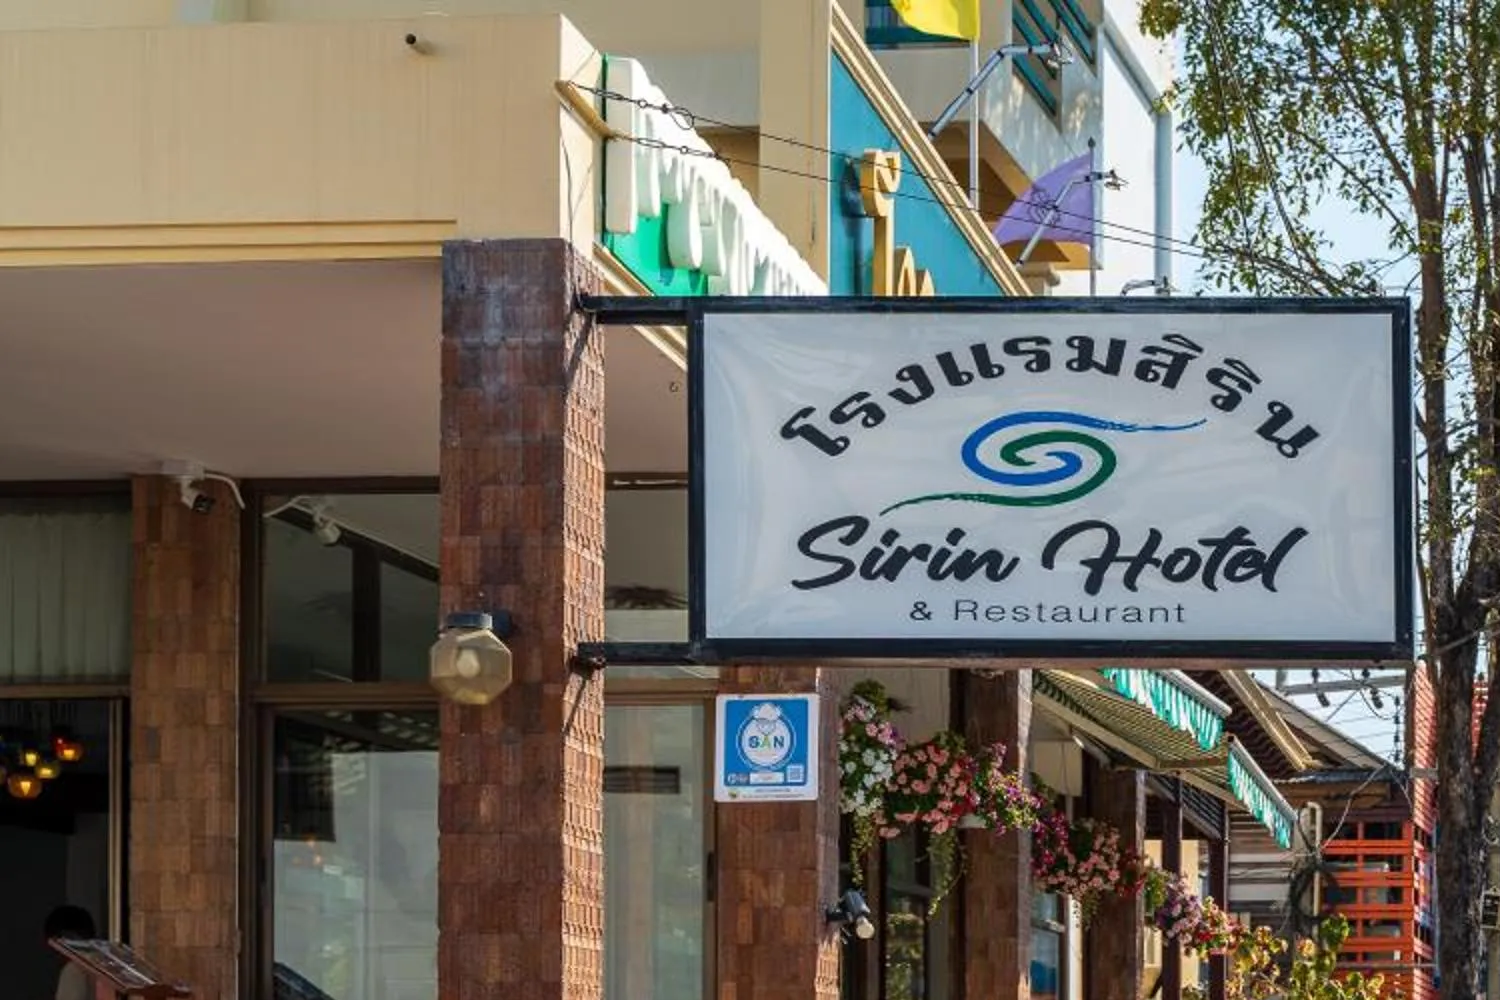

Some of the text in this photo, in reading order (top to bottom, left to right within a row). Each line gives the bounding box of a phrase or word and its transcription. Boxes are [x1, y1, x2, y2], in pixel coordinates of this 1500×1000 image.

[779, 332, 1322, 460] โรงแรมสิริน
[790, 513, 1310, 597] Sirin Hotel
[909, 599, 1185, 623] & Restaurant
